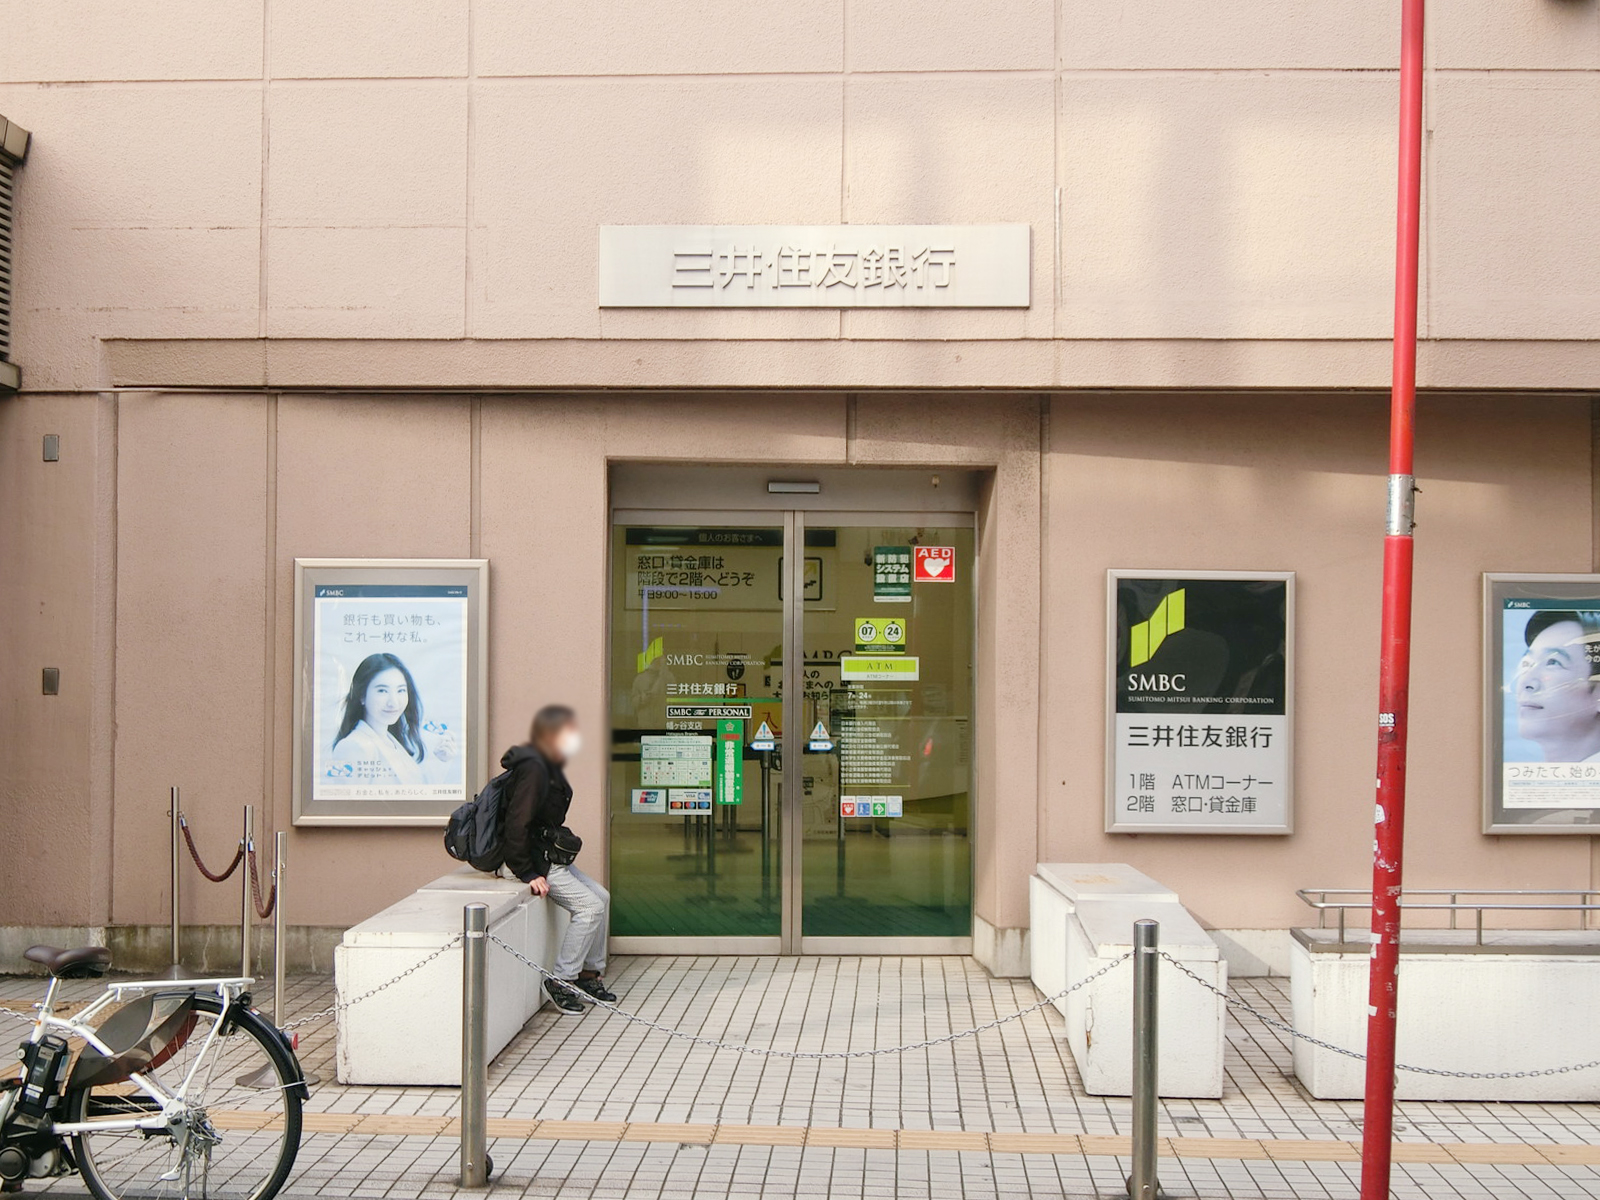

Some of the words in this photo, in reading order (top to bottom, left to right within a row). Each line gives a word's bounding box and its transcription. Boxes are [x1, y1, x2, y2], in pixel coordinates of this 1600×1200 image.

[672, 245, 956, 289] 三井住友銀行
[918, 549, 952, 557] AED
[637, 556, 725, 570] 窓口・貸金庫は
[876, 564, 909, 573] システム
[637, 572, 756, 587] 階段で2階へどうぞ
[326, 589, 344, 597] SMBC
[343, 614, 442, 627] 銀行も買い物も、
[343, 631, 429, 643] これ一枚な私。
[861, 626, 874, 636] 07
[887, 627, 900, 636] 24
[666, 654, 704, 666] SMBC
[1128, 673, 1186, 692] SMBC
[666, 683, 738, 695] 三井住友銀行
[1128, 695, 1166, 703] SUMITOMO
[1193, 696, 1224, 704] BANKING
[669, 708, 692, 716] SMBC
[708, 708, 749, 717] PERSONAL
[1128, 725, 1273, 748] 三井住友銀行
[1508, 766, 1600, 779] つみたて、始め
[1129, 773, 1156, 791] 1階
[1172, 774, 1274, 791] ATMコーナー
[1127, 795, 1155, 813] 2階
[1171, 796, 1258, 814] 窓口・貸金庫
